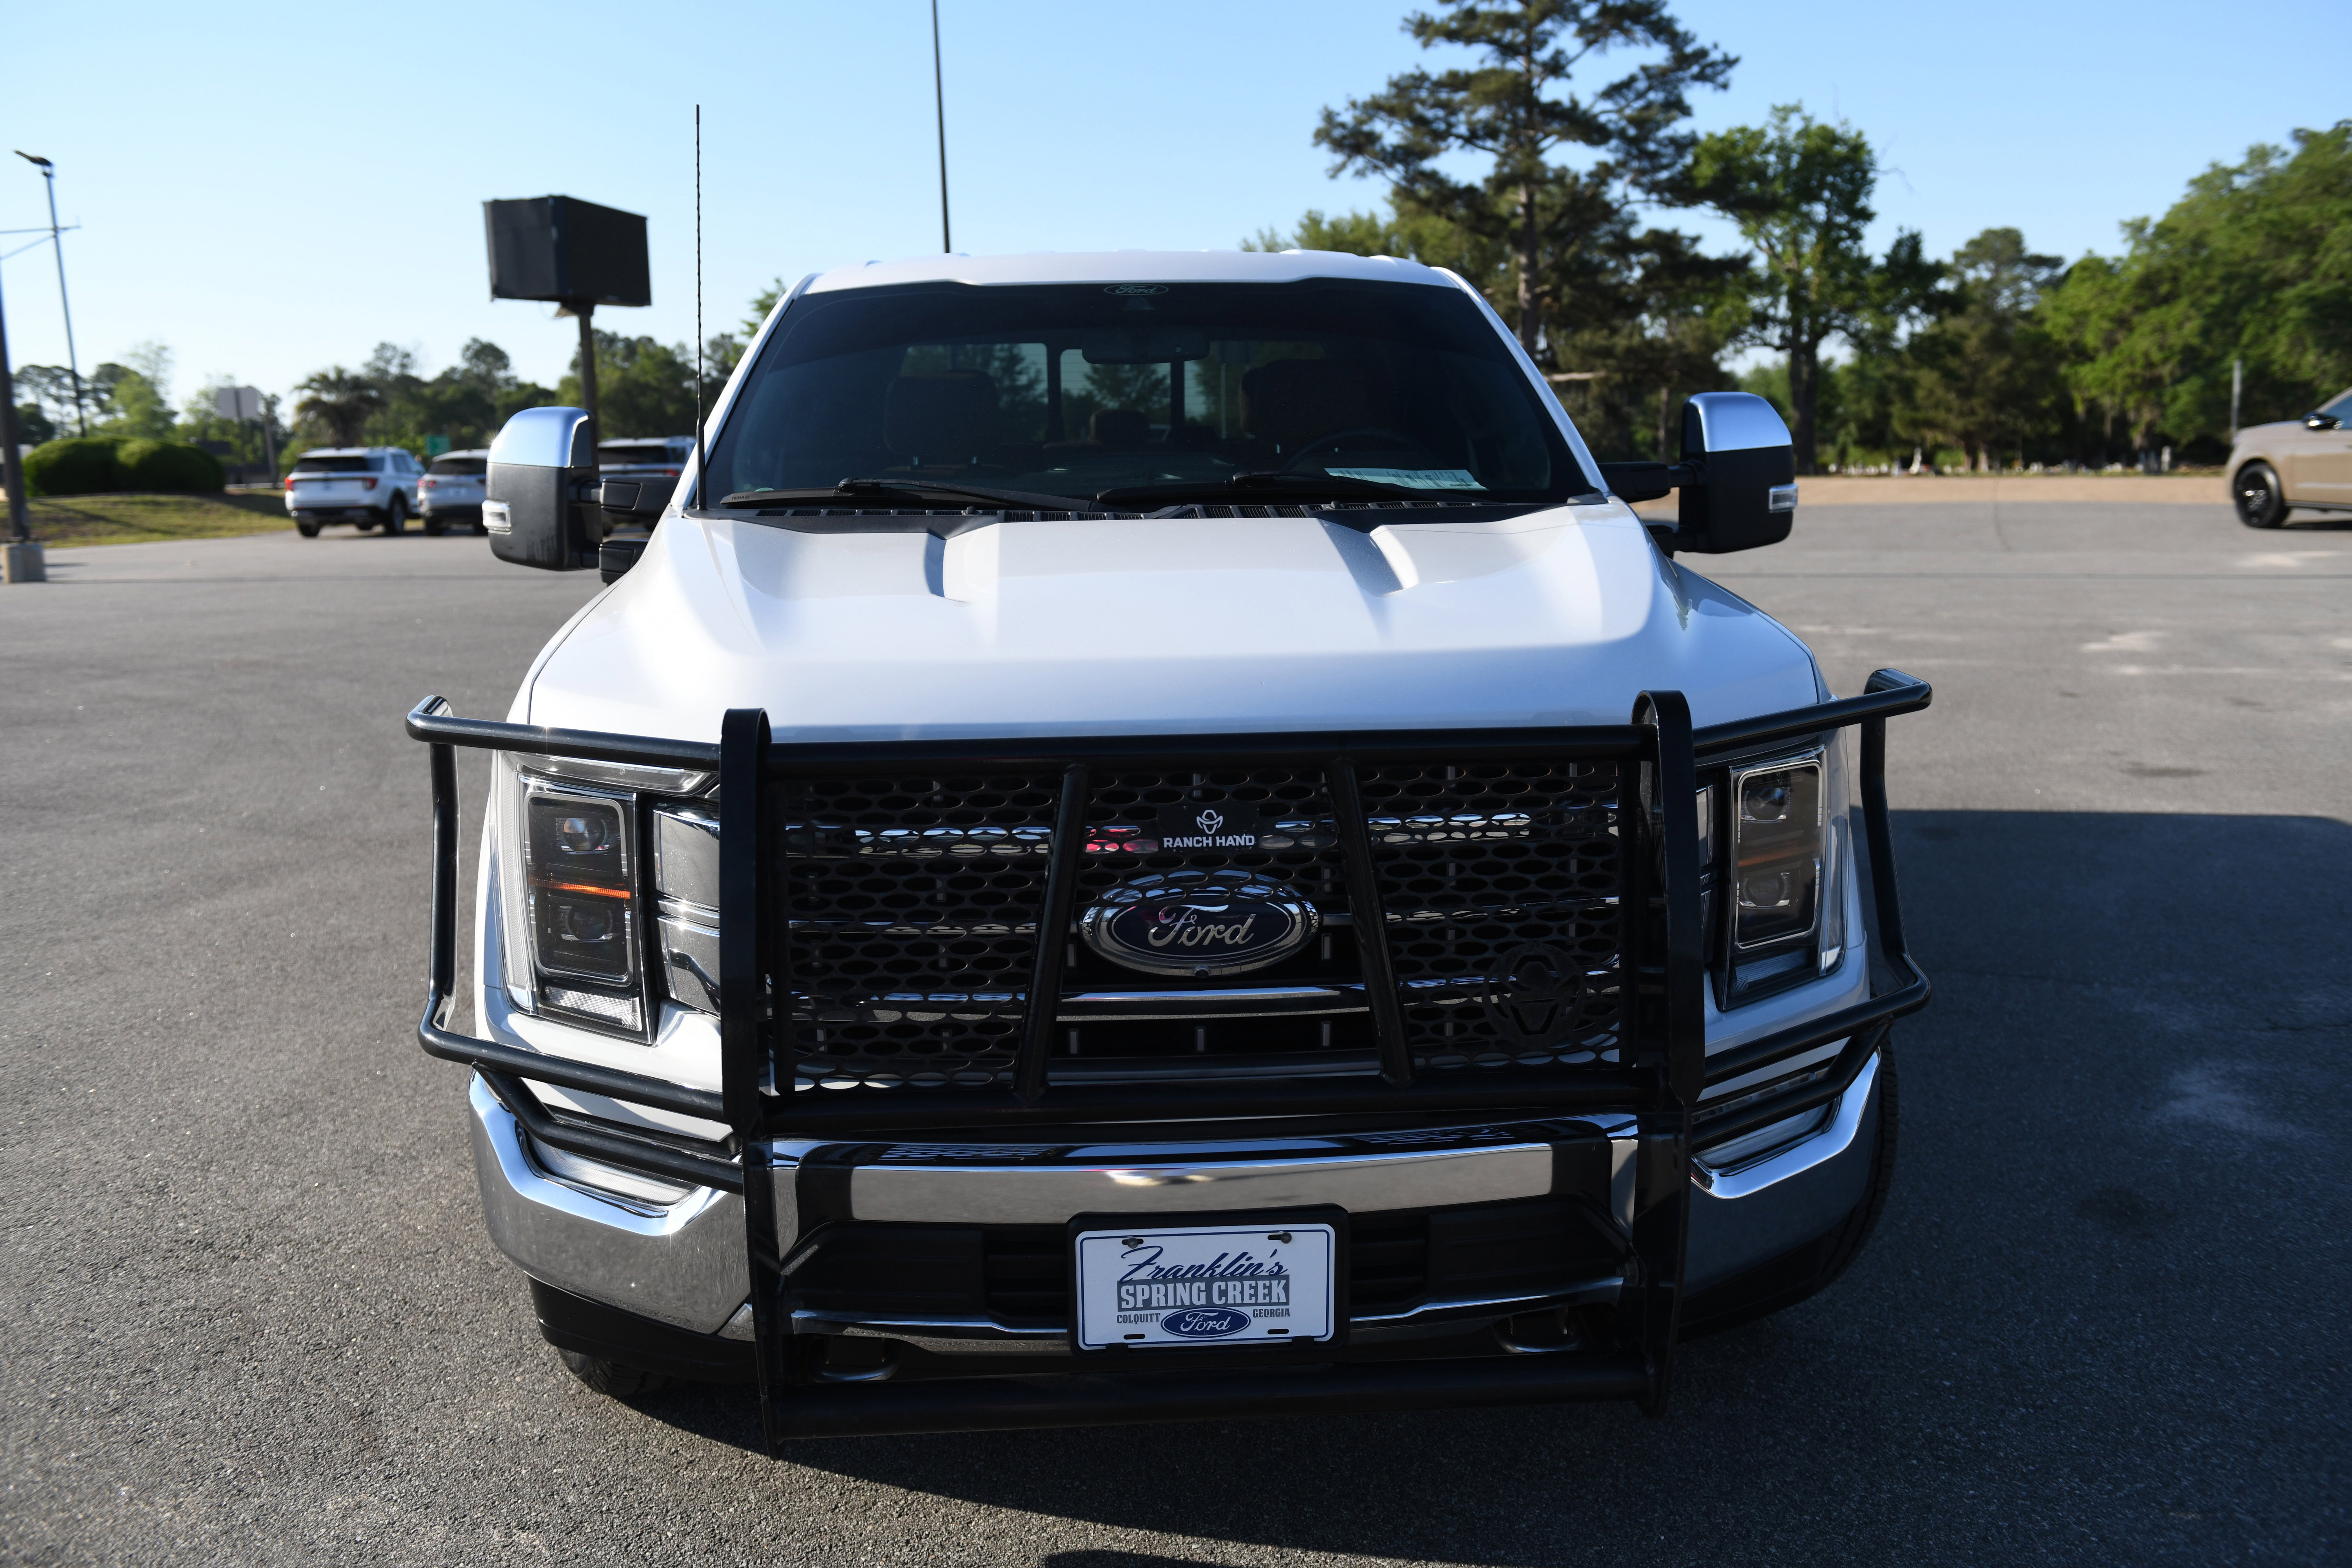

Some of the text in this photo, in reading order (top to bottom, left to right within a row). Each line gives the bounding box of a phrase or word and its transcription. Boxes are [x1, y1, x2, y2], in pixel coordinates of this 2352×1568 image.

[1116, 285, 1156, 294] Ford
[1163, 834, 1255, 848] RANCH HAND
[1148, 904, 1256, 947] Ford
[1119, 1245, 1288, 1283] Franklin's
[1120, 1280, 1287, 1309] SPRING CREEK
[1116, 1313, 1160, 1325] COLQUITT
[1180, 1312, 1232, 1332] Ford
[1252, 1308, 1290, 1319] GEORGIA
